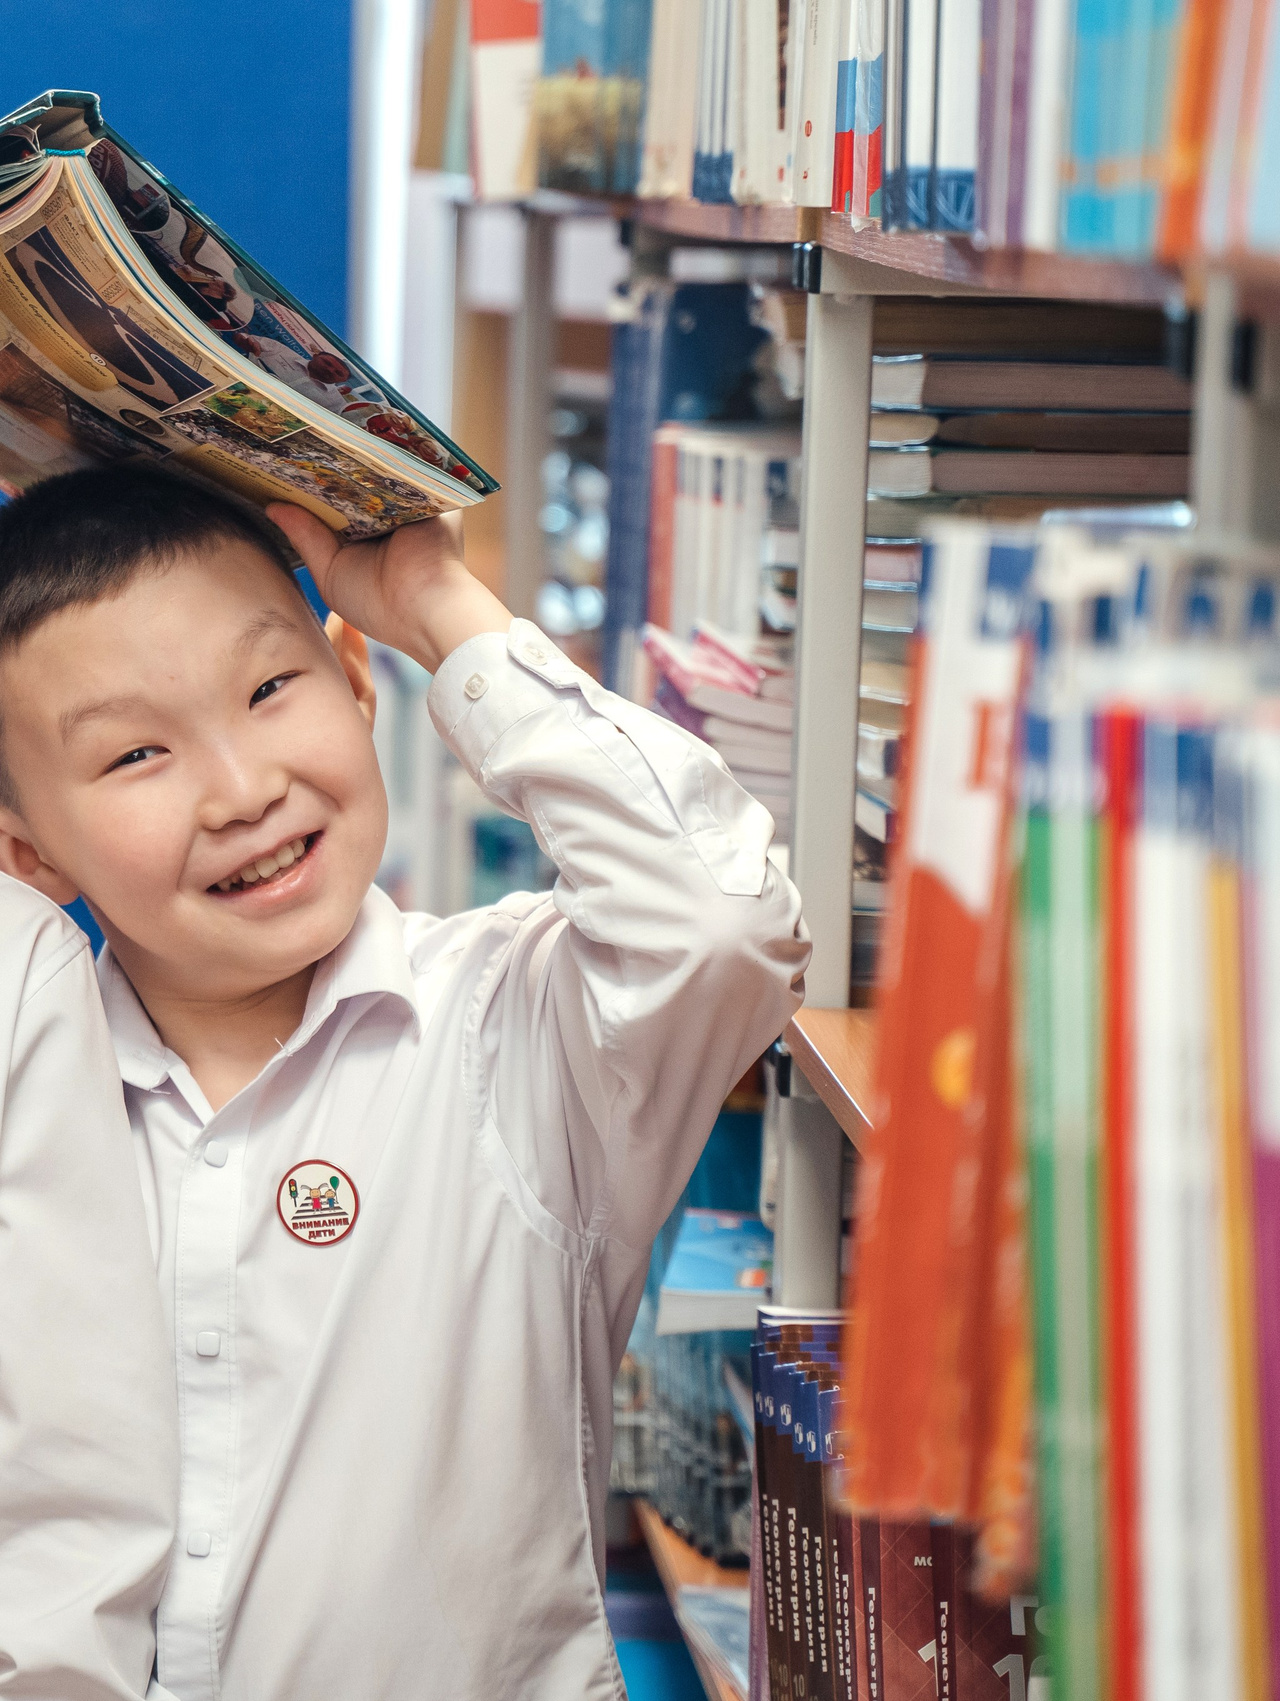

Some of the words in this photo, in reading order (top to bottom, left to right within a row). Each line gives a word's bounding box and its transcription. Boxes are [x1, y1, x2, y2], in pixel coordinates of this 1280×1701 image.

[292, 1218, 349, 1229] ВНИМАНИЕ
[308, 1229, 335, 1239] ДЕТИ
[772, 1498, 784, 1632] Геометрия
[787, 1507, 801, 1642] Геометрия
[801, 1526, 815, 1663] Геометрия
[814, 1536, 828, 1673] Геометрия
[793, 1674, 805, 1698] 10
